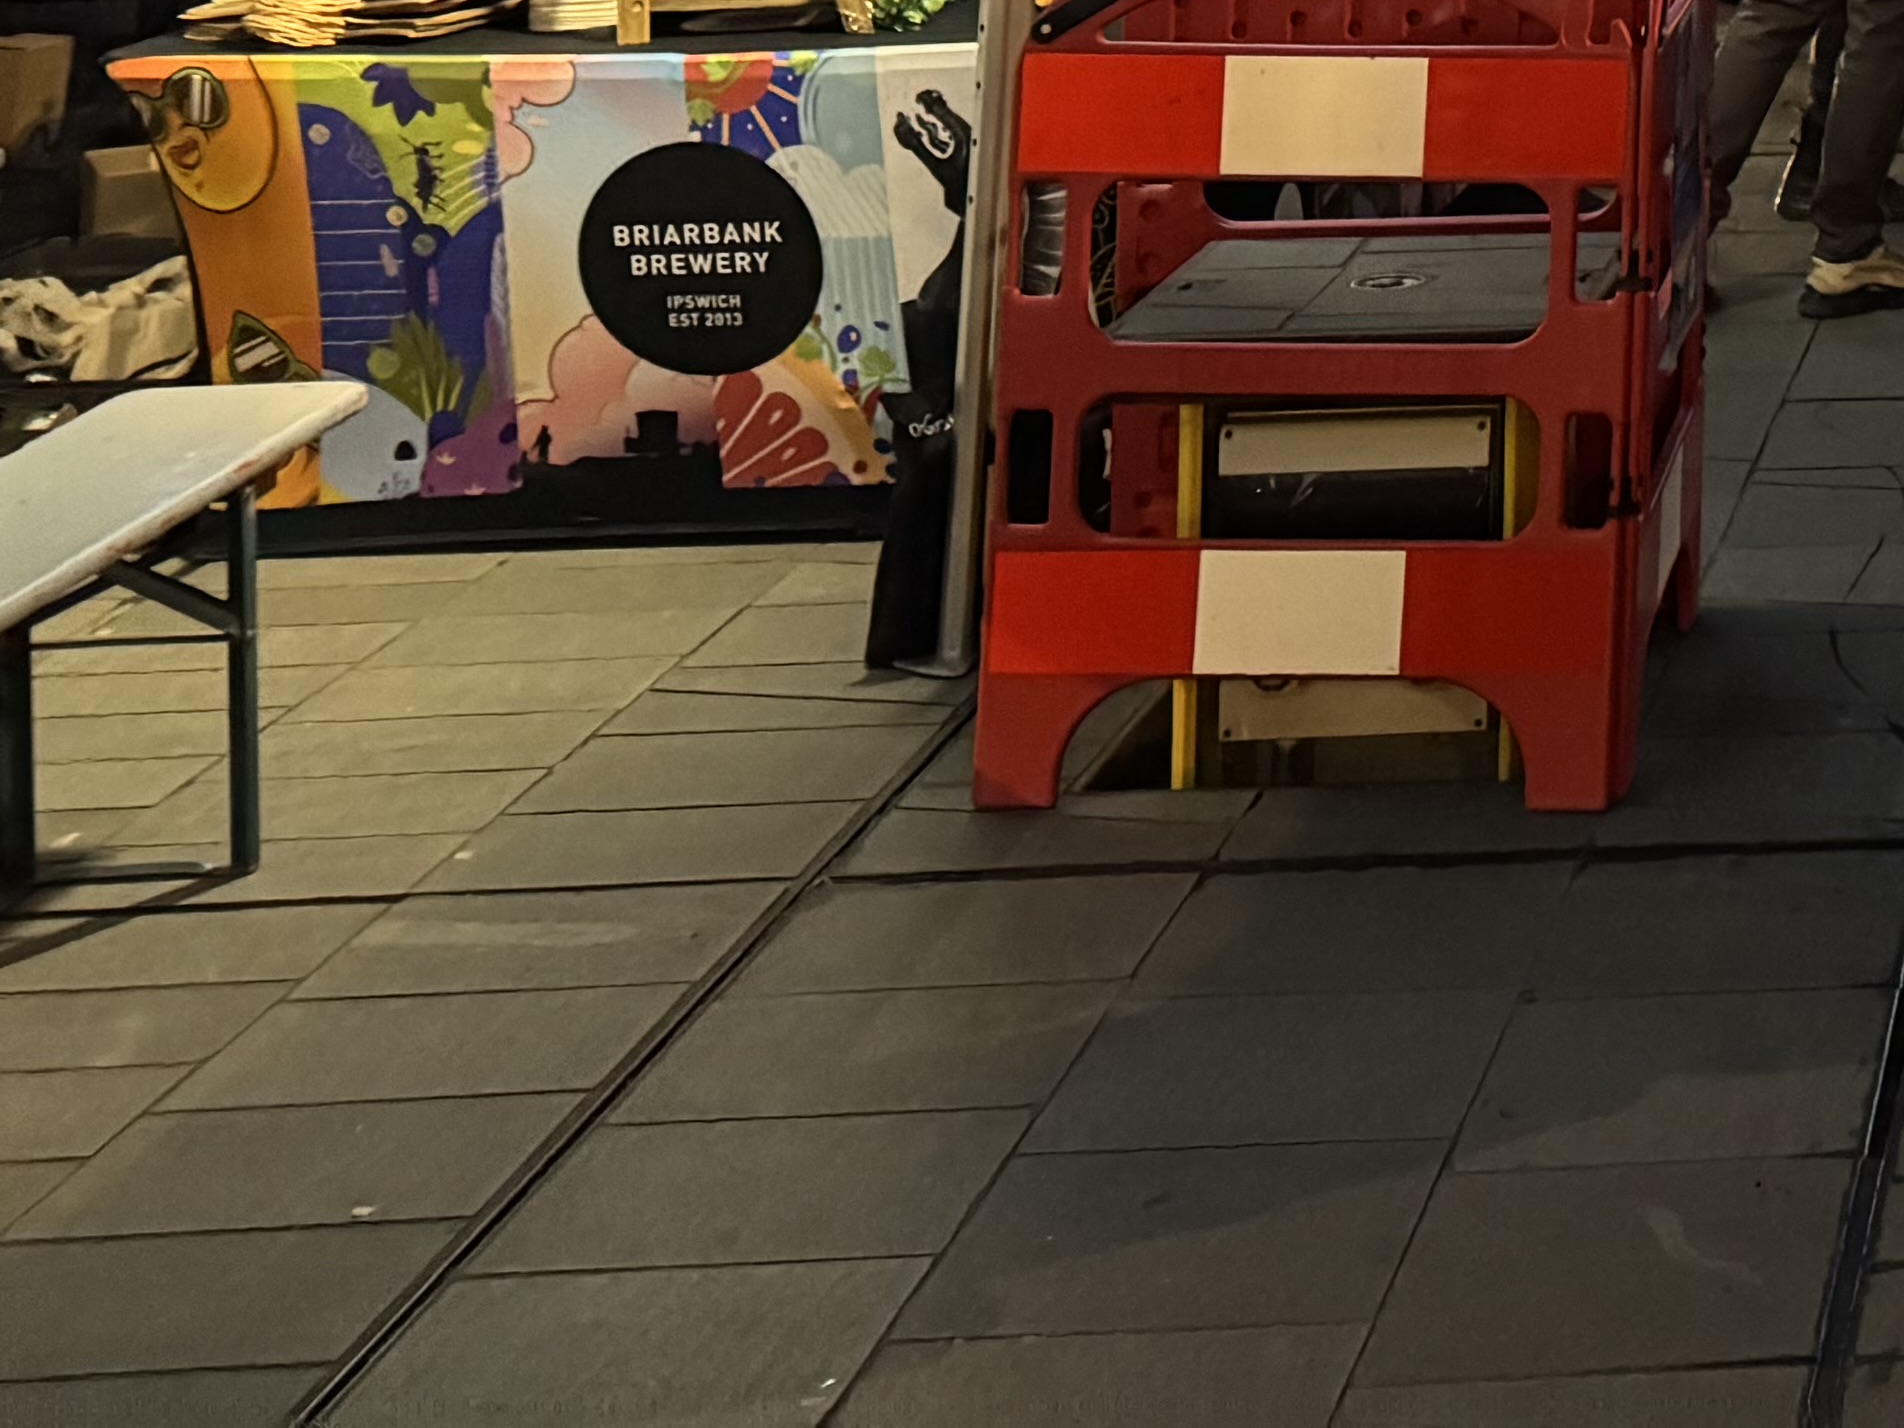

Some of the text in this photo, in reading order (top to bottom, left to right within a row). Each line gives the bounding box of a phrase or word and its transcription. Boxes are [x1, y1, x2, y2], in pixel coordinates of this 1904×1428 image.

[612, 221, 783, 247] BRIARBANK
[630, 252, 770, 276] BREWERY
[667, 294, 741, 309] IPSWICH
[668, 313, 743, 327] EST 2013
